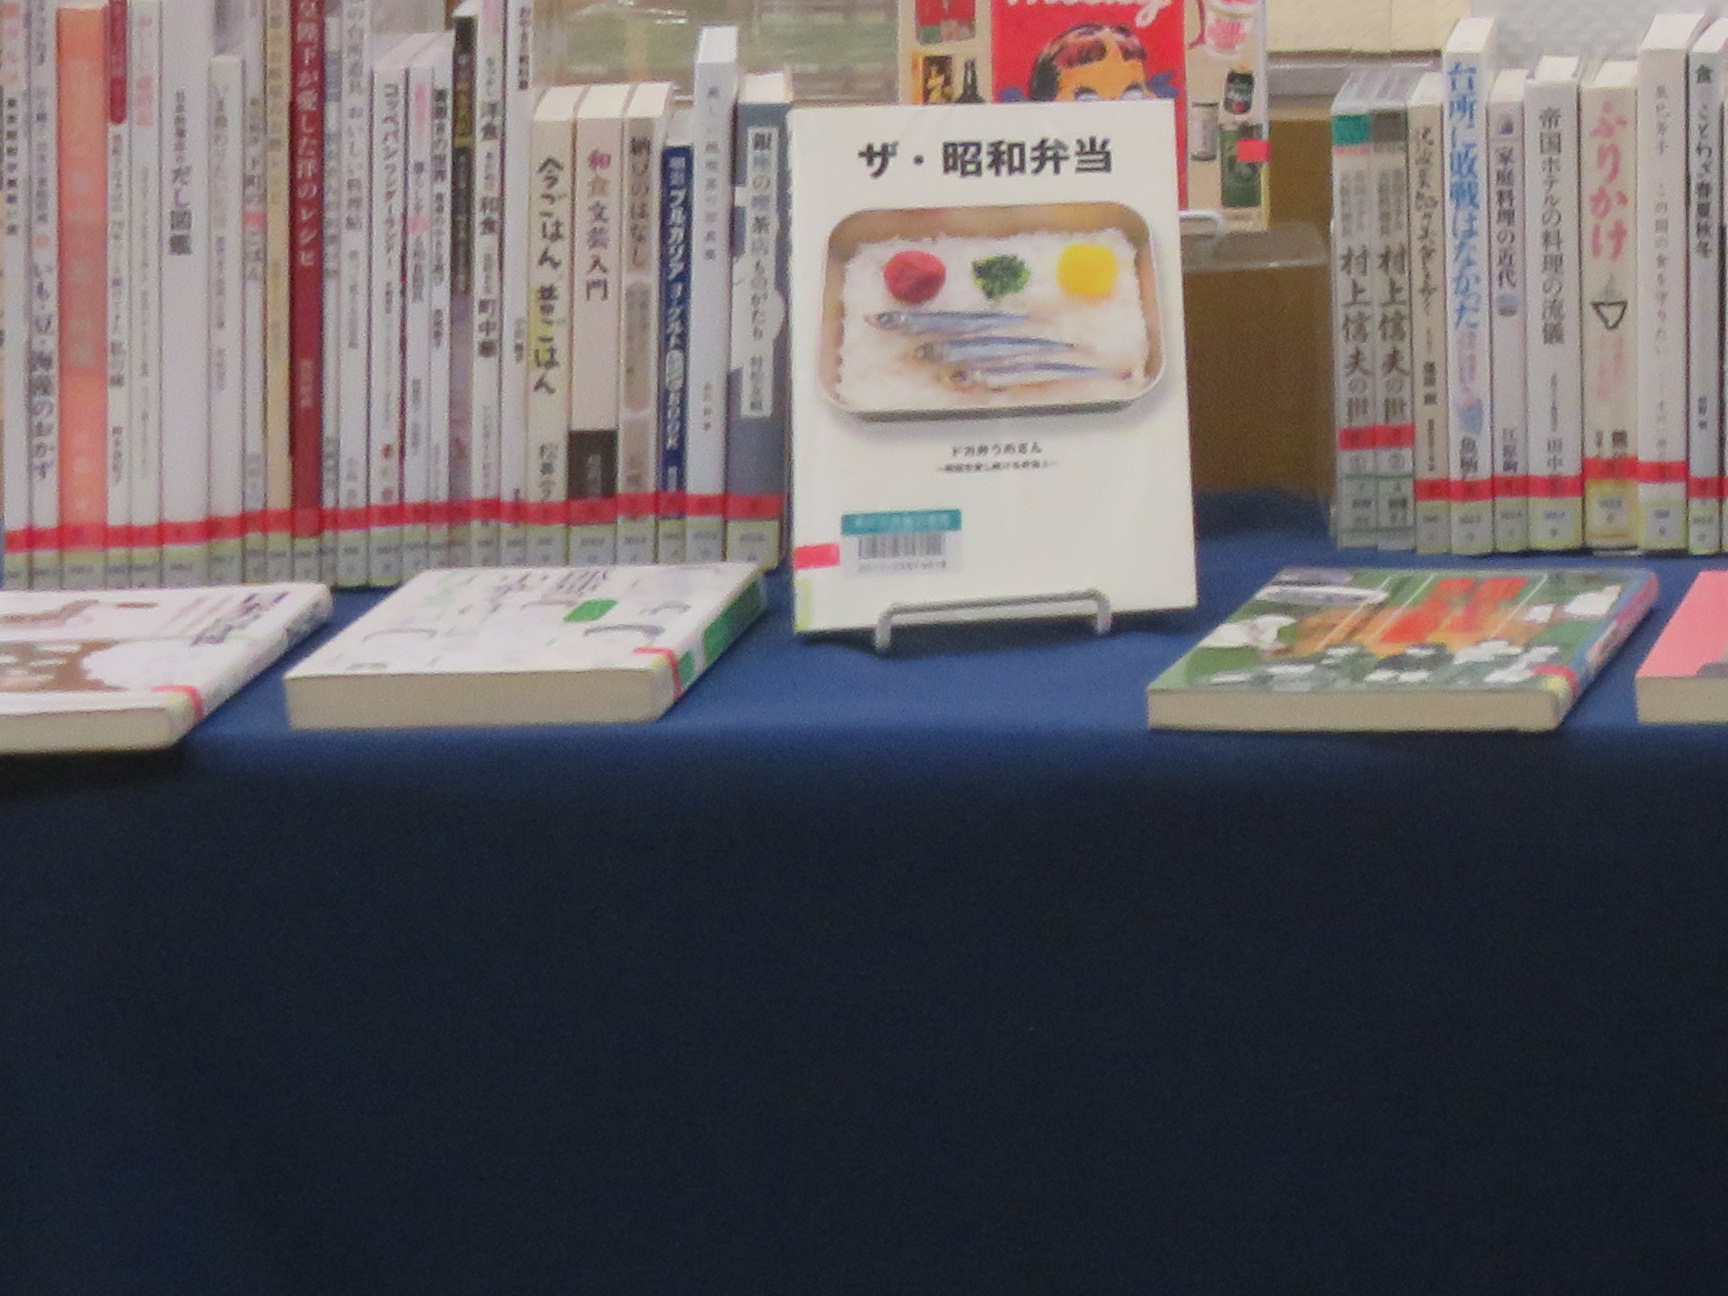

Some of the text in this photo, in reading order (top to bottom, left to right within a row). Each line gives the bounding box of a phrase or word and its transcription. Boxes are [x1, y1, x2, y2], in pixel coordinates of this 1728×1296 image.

[537, 156, 566, 270] 今ごはん
[858, 136, 1112, 180] ザ・昭和弁当
[1447, 61, 1481, 329] 台所に敗戦はなかった
[1494, 146, 1517, 289] 家庭料理の近代
[1538, 108, 1566, 345] 帝国ホテルの料理の流儀
[1589, 100, 1627, 261] ふりかけ
[1340, 244, 1372, 426] 村上信夫の世
[1376, 244, 1411, 426] 村上信夫の世
